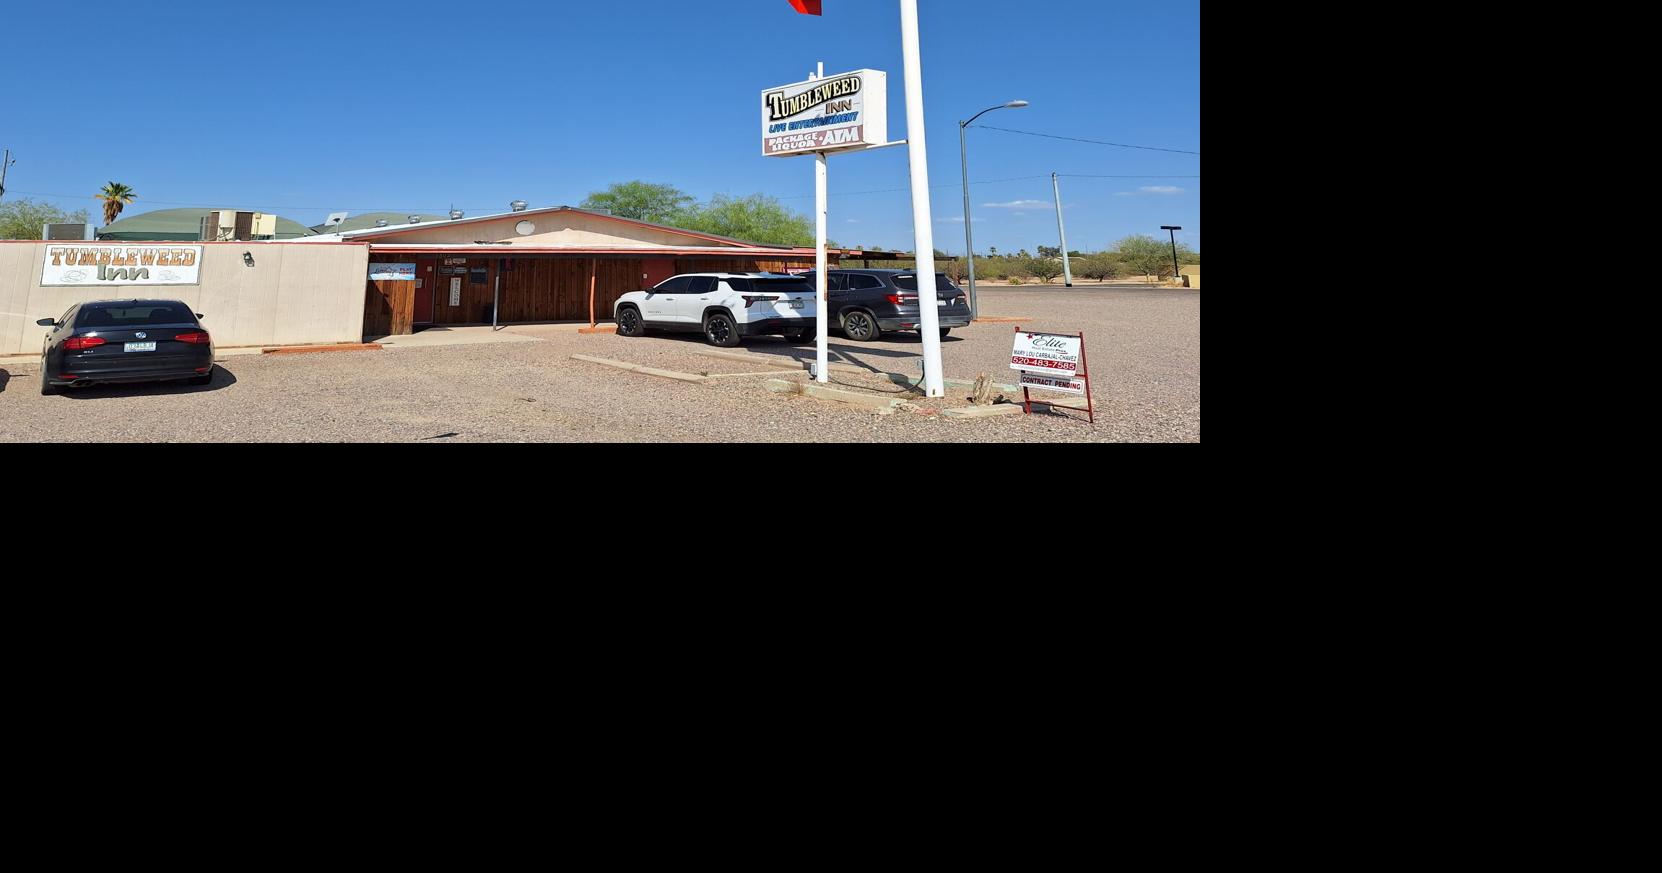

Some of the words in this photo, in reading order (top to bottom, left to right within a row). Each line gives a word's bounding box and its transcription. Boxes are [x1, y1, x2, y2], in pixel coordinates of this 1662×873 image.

[767, 76, 861, 121] TUMBLEWEED
[825, 99, 852, 115] INN
[769, 122, 786, 133] LIVE
[788, 111, 858, 130] ENTERTAINMENT
[769, 132, 818, 146] PACKAGE
[821, 127, 860, 146] ATM
[772, 140, 816, 151] LIQUOR
[50, 247, 196, 266] TUMBLEWEED
[97, 264, 149, 281] Inn
[1032, 335, 1067, 349] Elite
[1013, 356, 1075, 370] 520-483-7585
[1022, 376, 1052, 386] CONTRACT
[1055, 380, 1081, 390] PENDING
